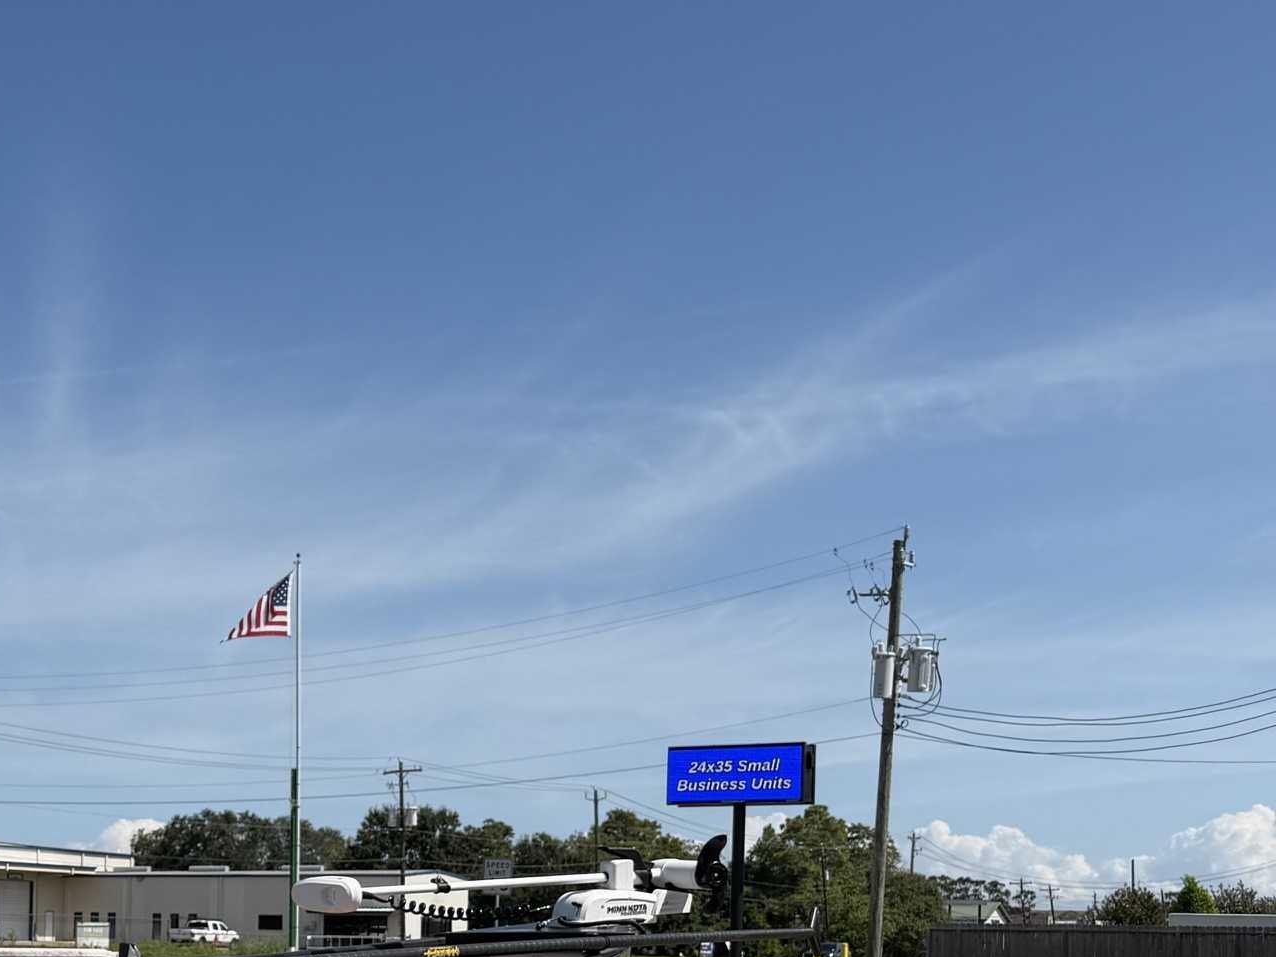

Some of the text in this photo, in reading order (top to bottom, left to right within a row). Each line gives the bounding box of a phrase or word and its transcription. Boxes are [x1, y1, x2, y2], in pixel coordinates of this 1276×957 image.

[688, 758, 780, 774] 24x35 Small
[677, 776, 792, 792] Business Units
